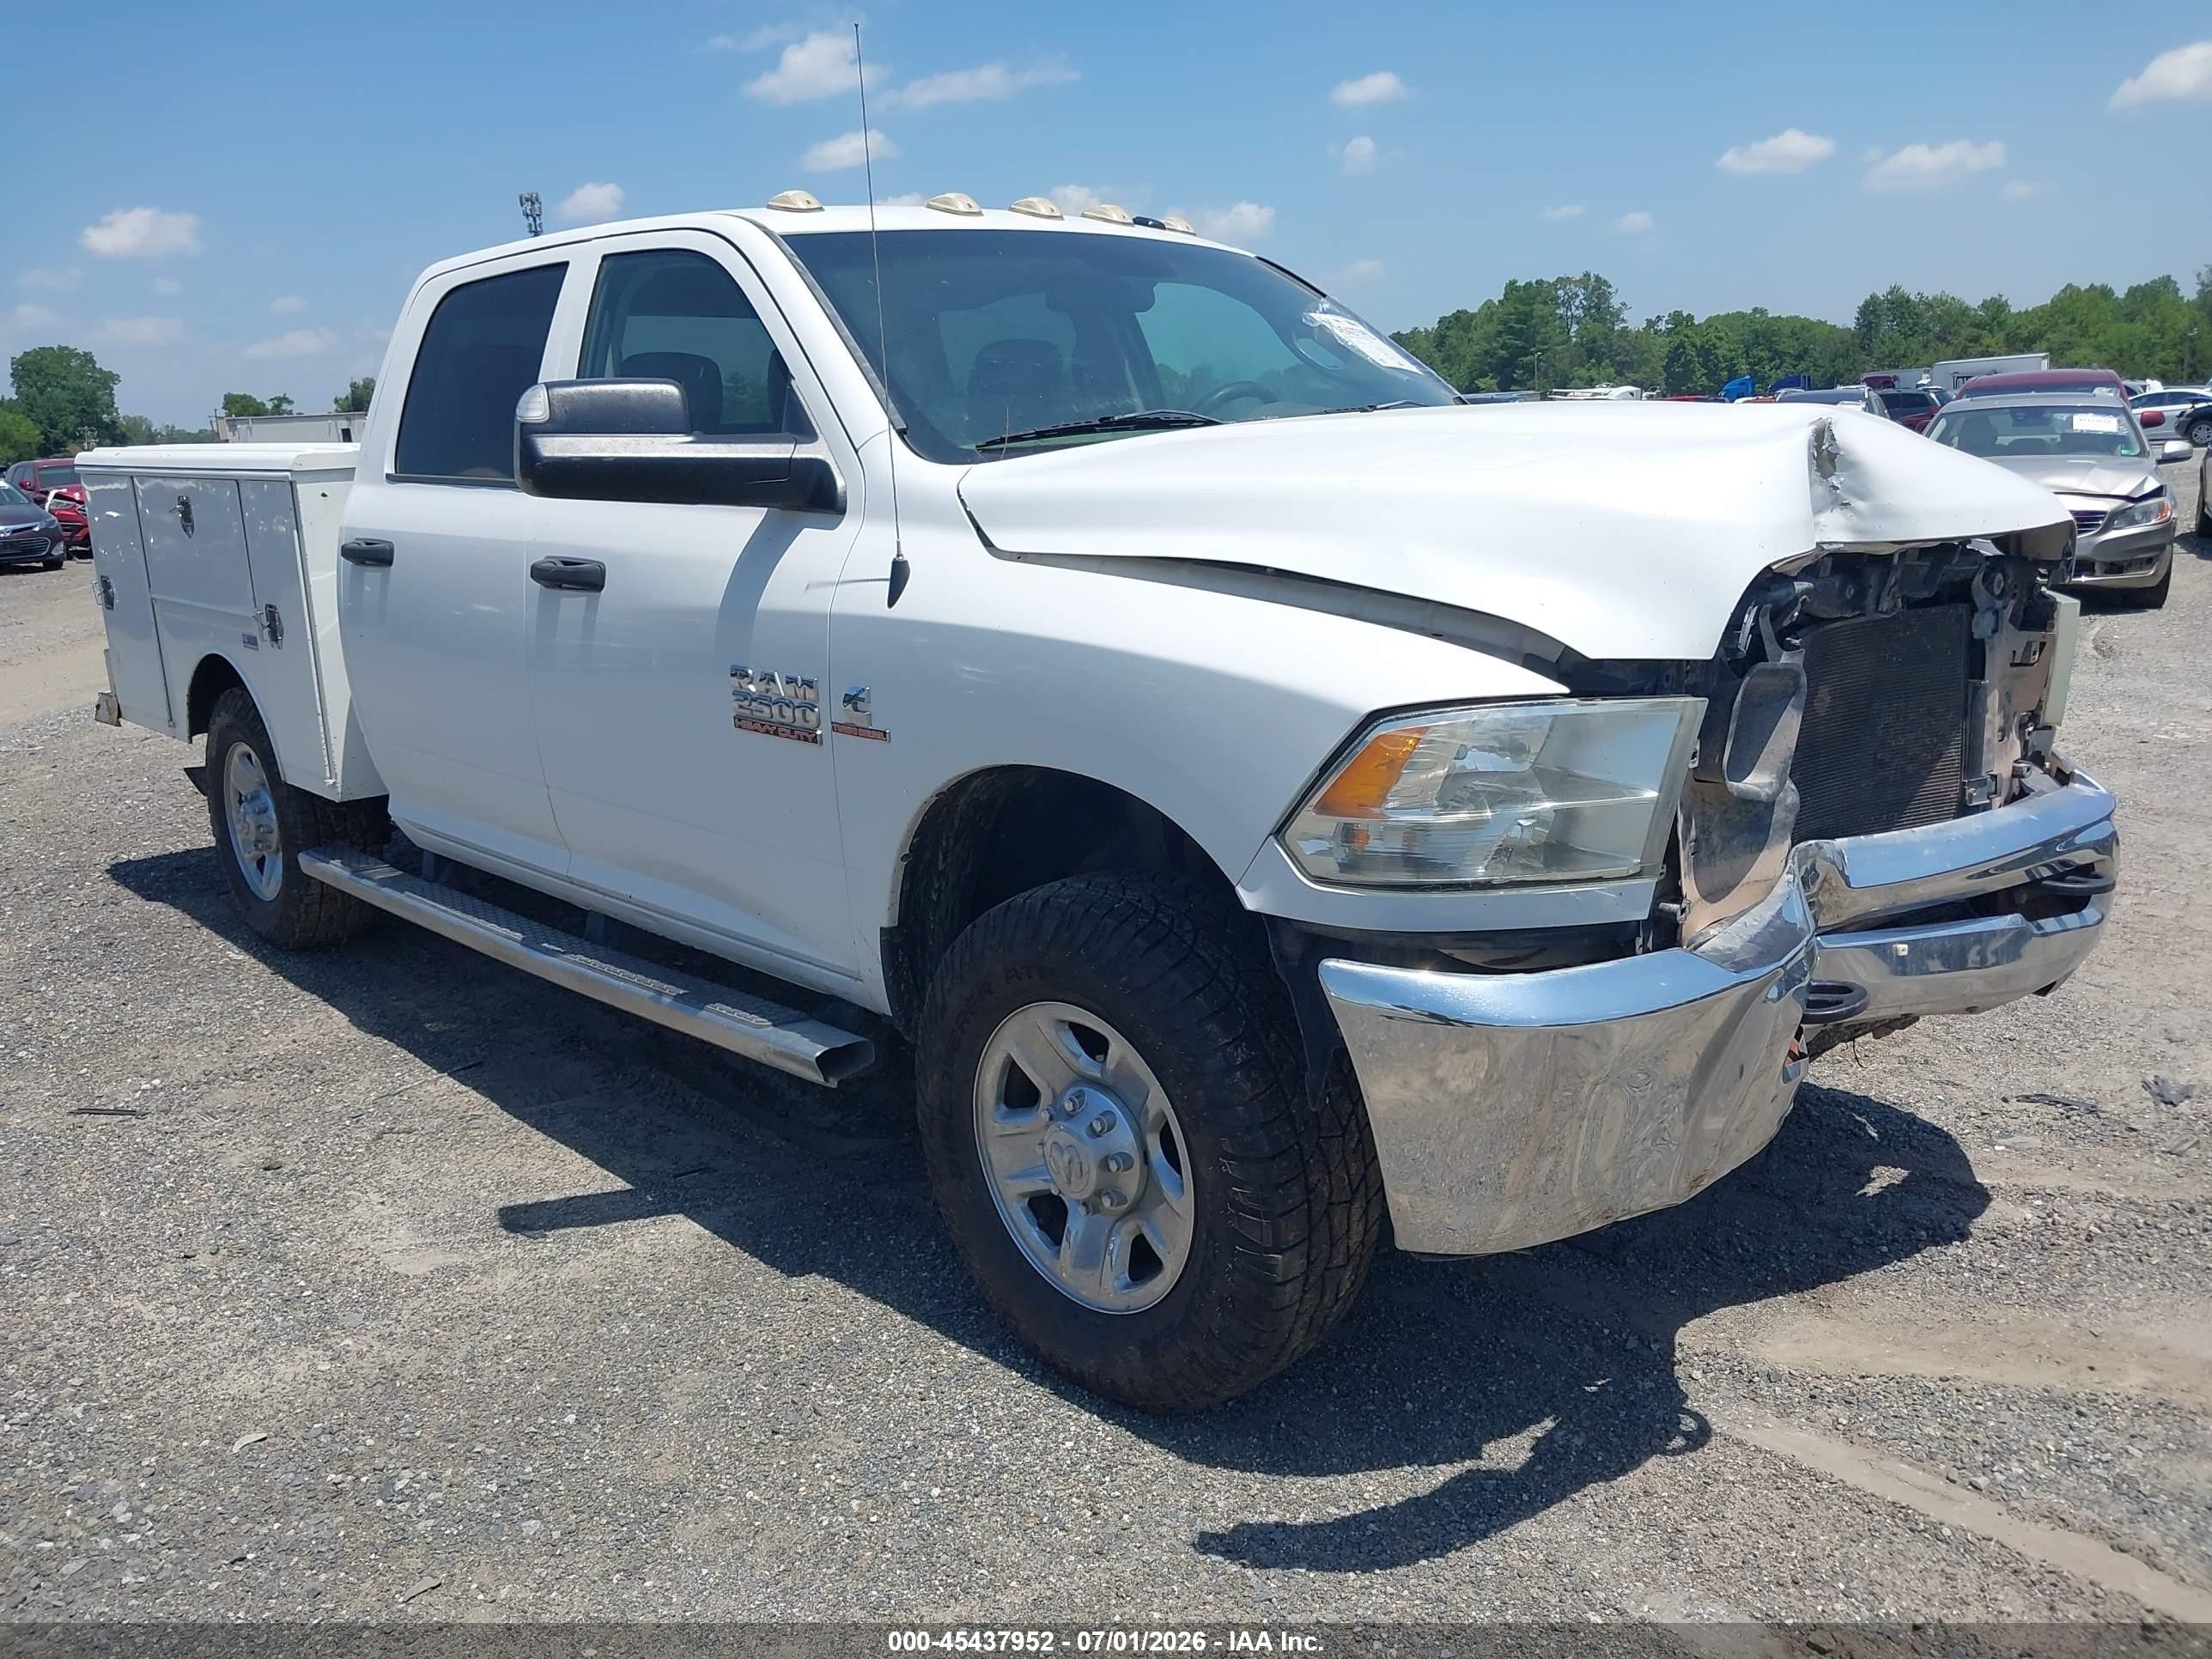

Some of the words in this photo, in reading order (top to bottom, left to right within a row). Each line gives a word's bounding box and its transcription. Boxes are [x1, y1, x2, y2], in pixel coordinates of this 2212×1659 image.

[729, 665, 818, 702] RAM
[732, 690, 820, 728] 2500
[736, 719, 776, 734] HEAVY
[778, 727, 816, 743] DUTY
